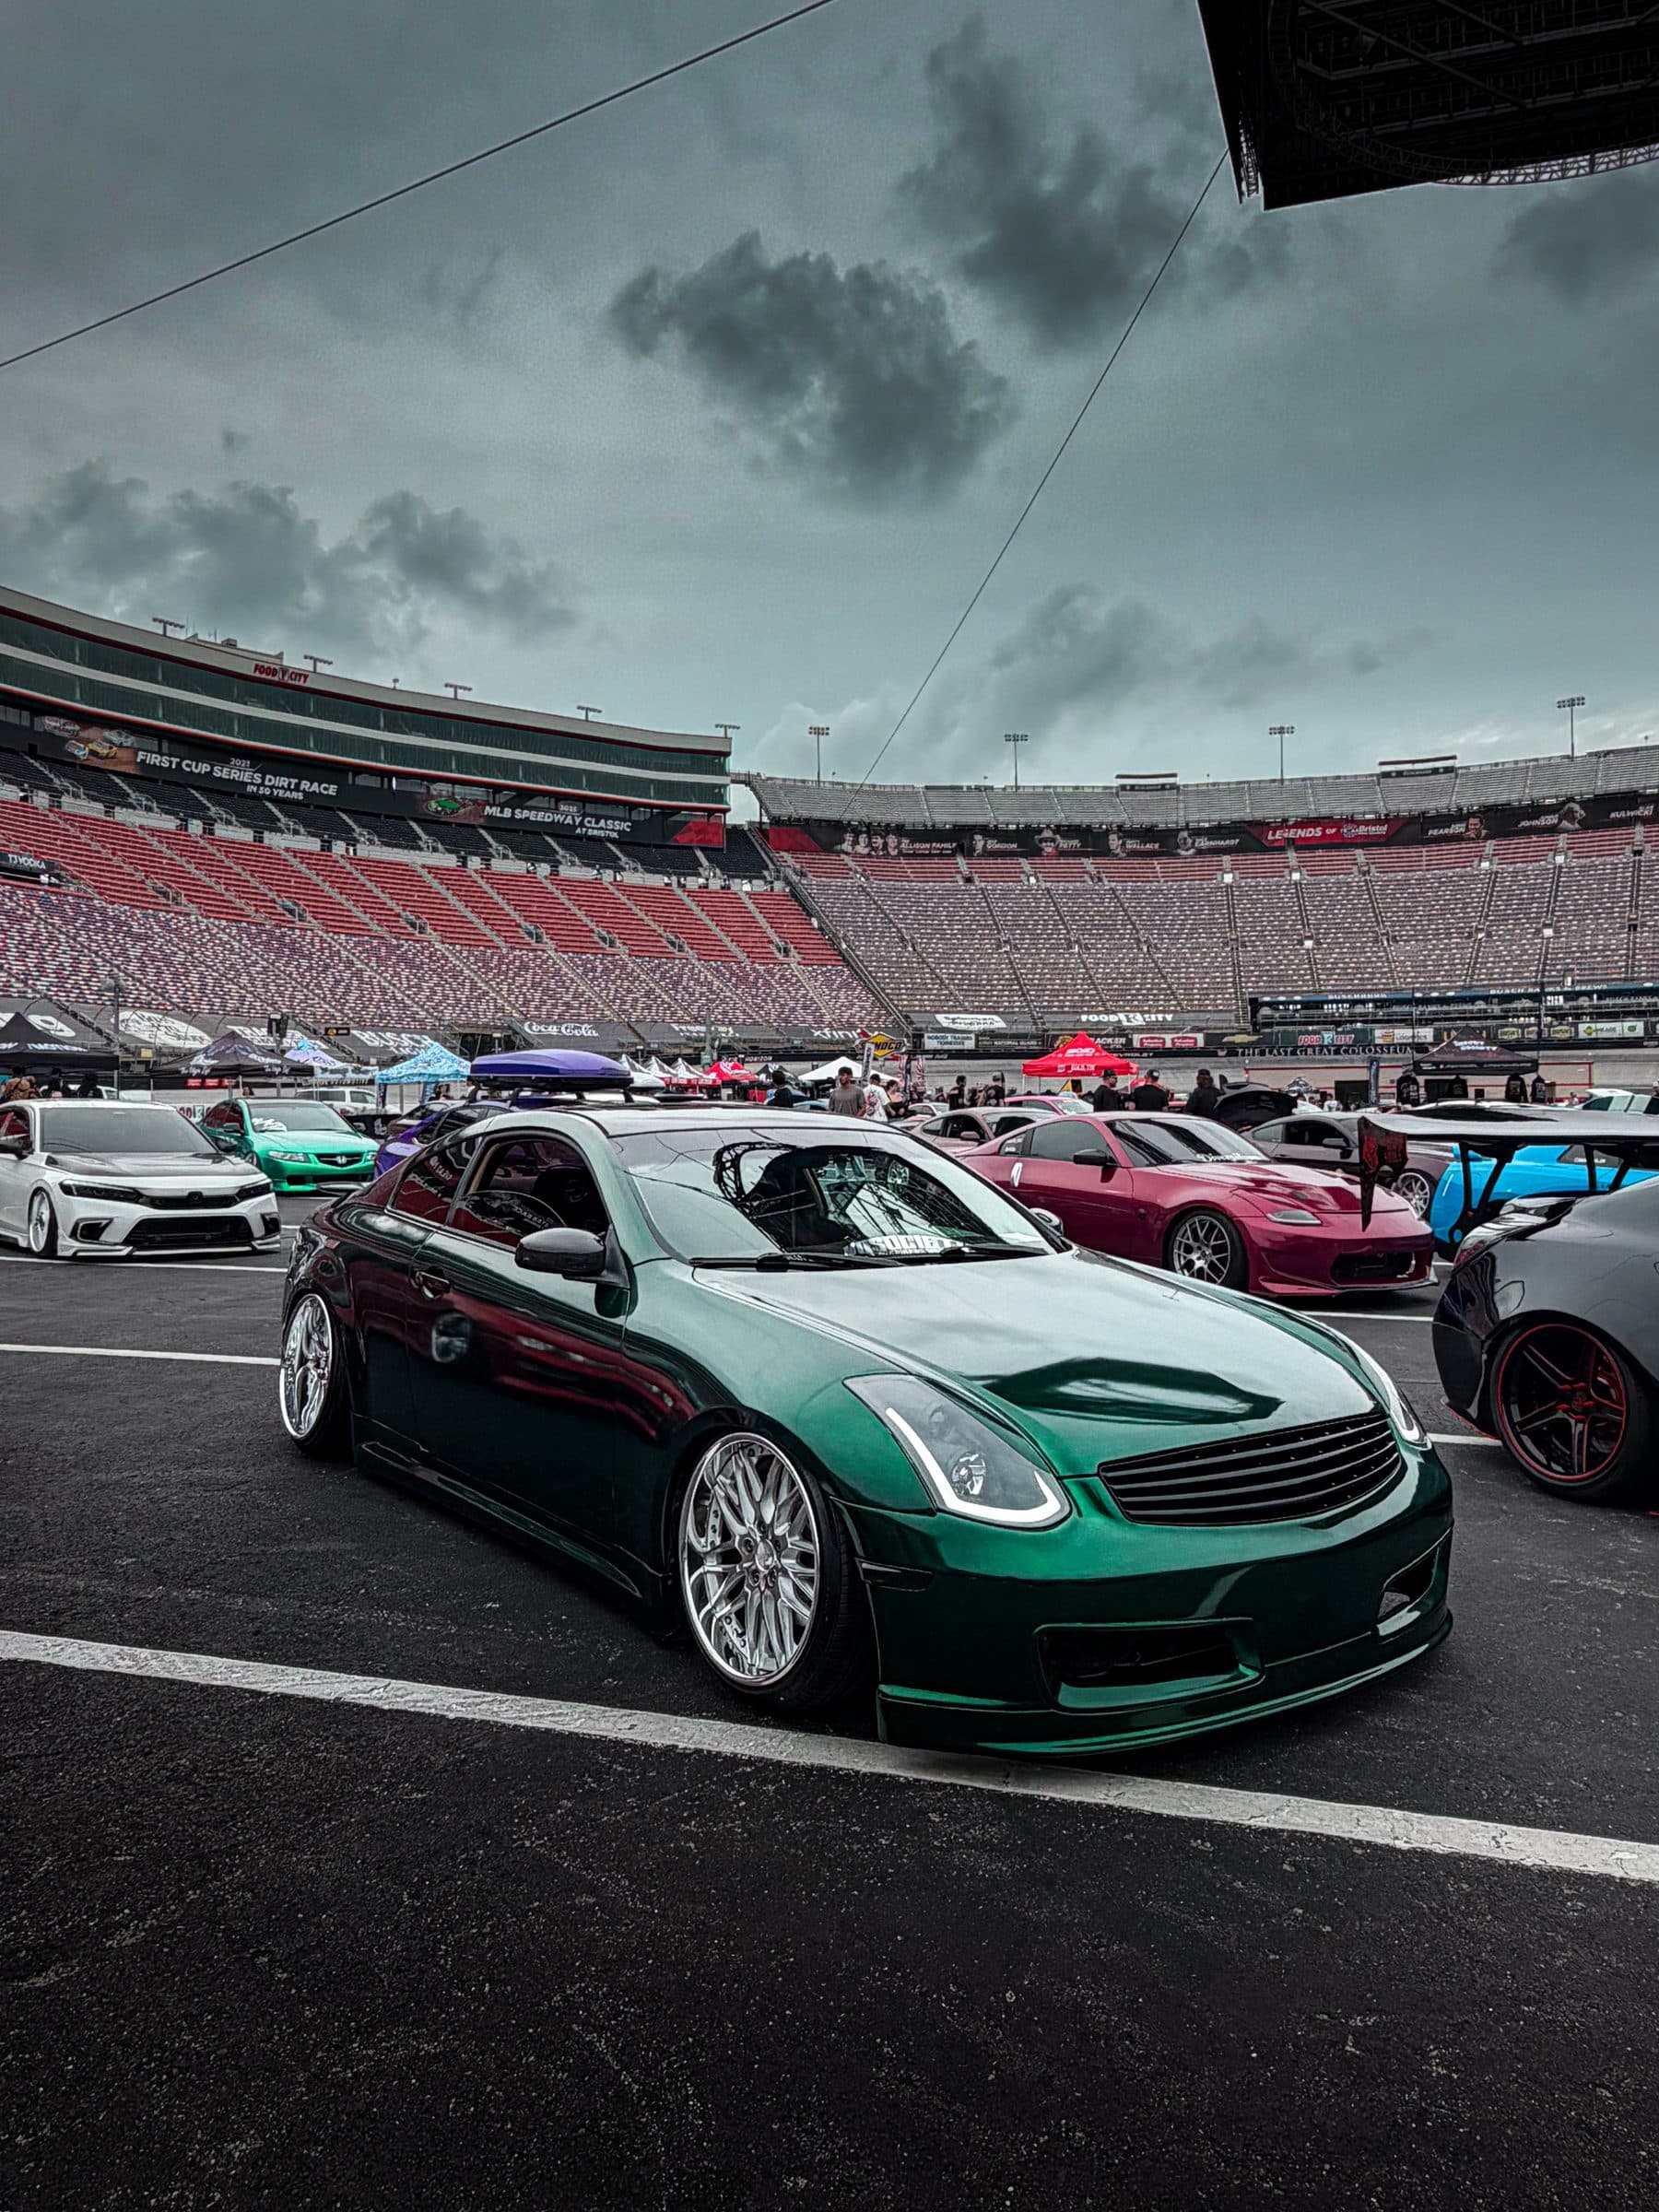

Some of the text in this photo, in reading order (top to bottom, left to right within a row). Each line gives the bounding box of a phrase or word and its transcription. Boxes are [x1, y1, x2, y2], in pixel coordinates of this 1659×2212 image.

[253, 664, 278, 677] FOOD
[289, 671, 310, 684] CITY
[230, 758, 250, 768] 2021
[136, 751, 338, 796] FIRST CUP SERIES DIRT RACE
[246, 784, 304, 800] IN 50 YEARS
[484, 806, 632, 832] MLB SPEEDWAY CLASSIC
[1518, 818, 1559, 829] JOHNSON
[1358, 824, 1388, 832] Bristol
[587, 829, 619, 839] BRISTOL
[1267, 827, 1323, 841] LEGENDS
[1081, 1014, 1120, 1022] FOOD
[811, 1028, 872, 1040] xfini
[1298, 1034, 1322, 1045] FOOD
[1335, 1034, 1355, 1044] CITY
[860, 1041, 902, 1051] SNOCO
[1236, 1048, 1264, 1057] THE
[1265, 1047, 1295, 1056] LAST
[1297, 1047, 1337, 1056] GREAT
